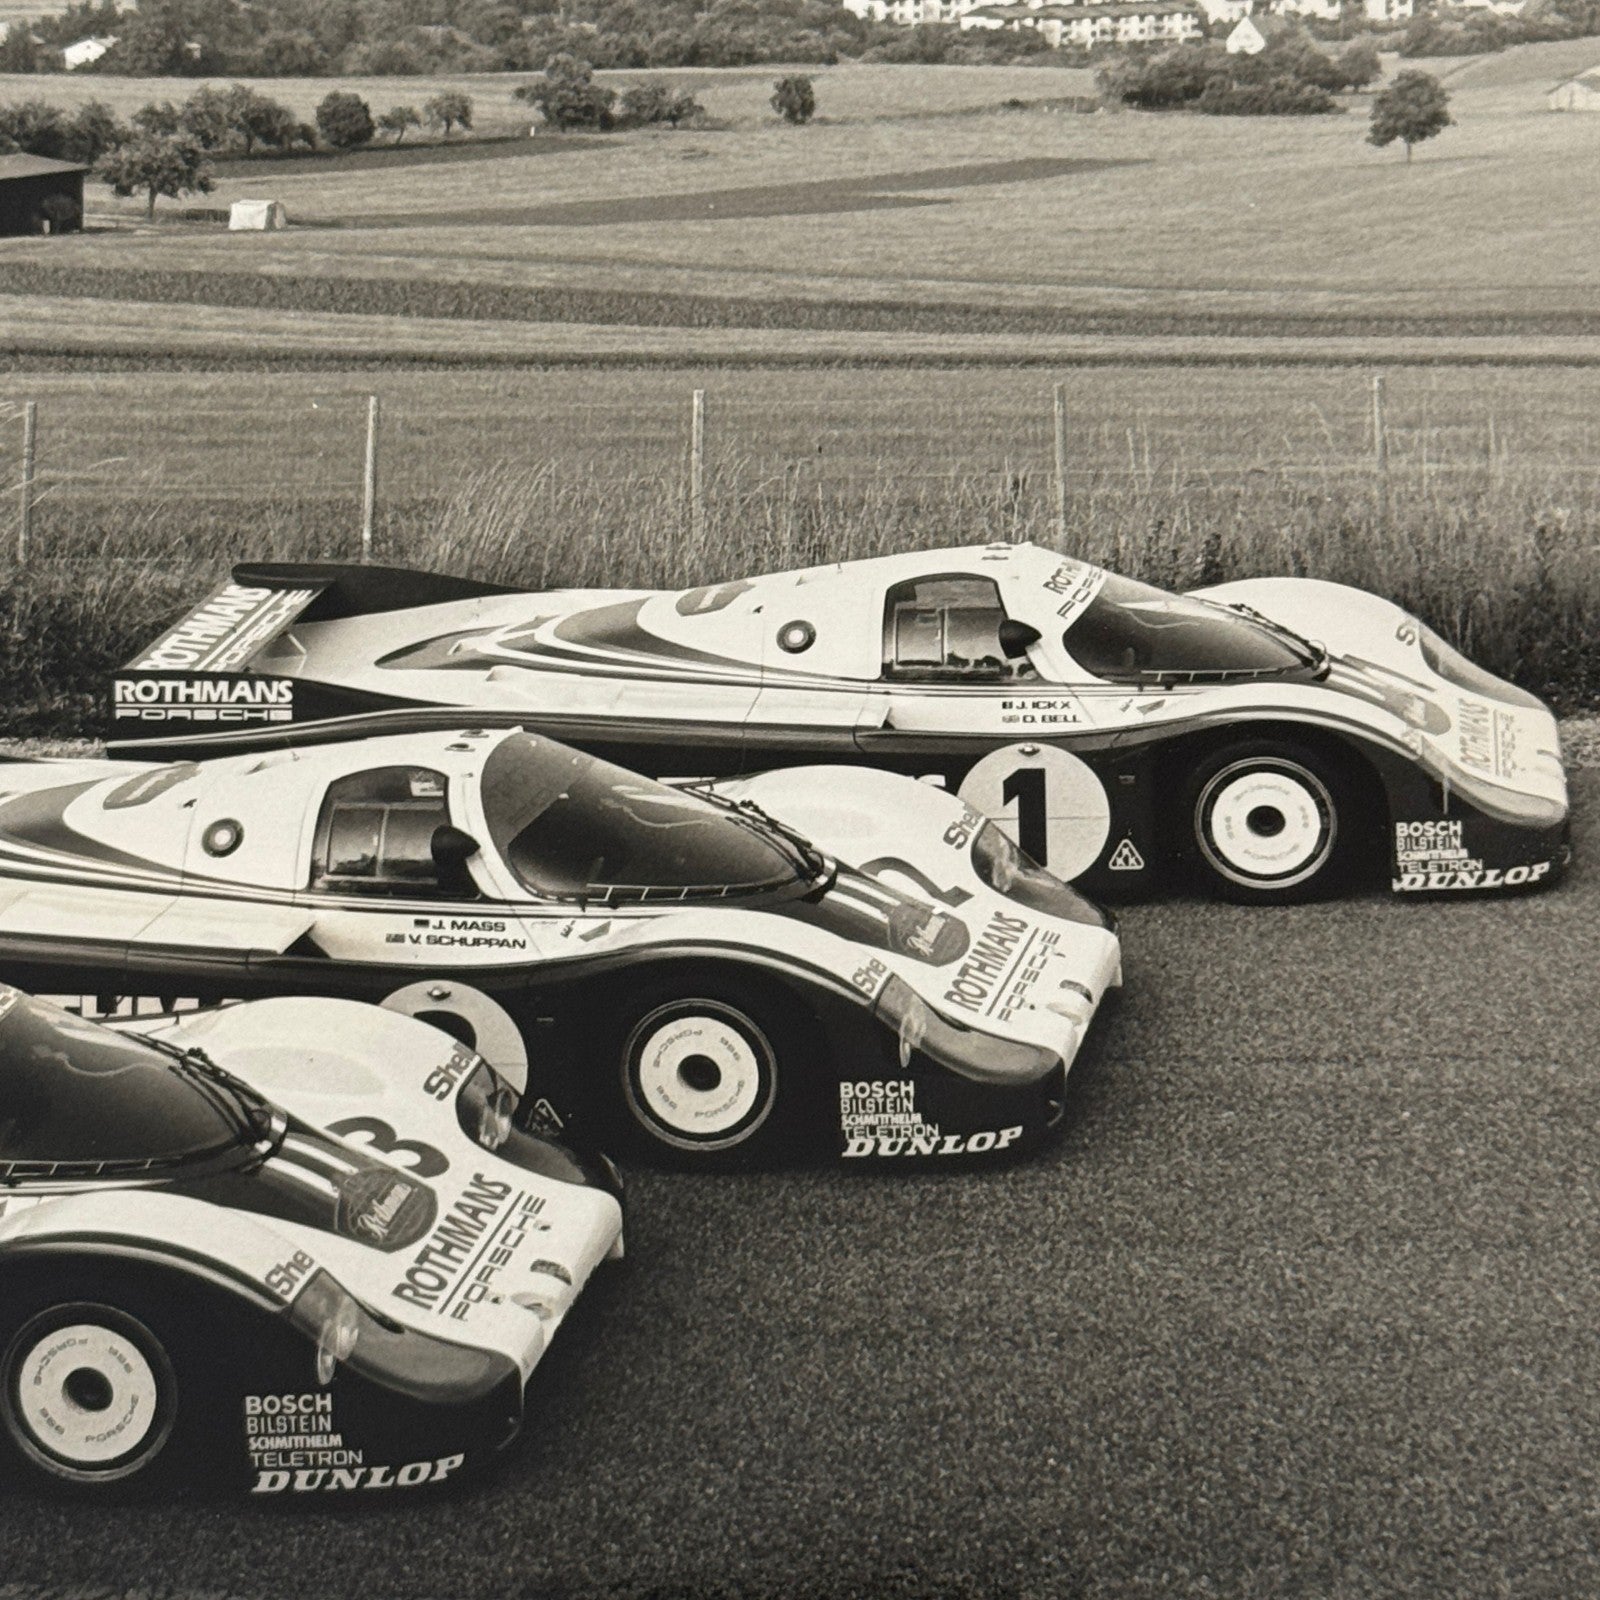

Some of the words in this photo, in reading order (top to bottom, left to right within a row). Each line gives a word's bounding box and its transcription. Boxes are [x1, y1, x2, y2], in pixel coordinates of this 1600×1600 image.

[114, 679, 293, 704] ROTHMANS
[115, 709, 293, 721] PORSCHE
[1041, 714, 1081, 724] BELL
[1003, 768, 1047, 867] 1
[1395, 820, 1462, 838] BOSCH
[1396, 836, 1461, 851] BILSTEIN
[1397, 859, 1484, 874] TELETRON
[1392, 862, 1551, 893] DUNLOP
[432, 922, 446, 932] J.
[450, 921, 506, 933] MASS
[408, 934, 421, 945] V.
[425, 934, 527, 949] SCHUPPAN
[943, 910, 1029, 1013] ROTHMANS
[997, 930, 1061, 1023] PORSCHE
[840, 1080, 914, 1099] BOSCH
[841, 1098, 914, 1114] BILSTEIN
[841, 1125, 1023, 1158] DUNLOP
[842, 1123, 939, 1140] TELETRON
[391, 1172, 512, 1310] ROTHMANS
[450, 1194, 546, 1322] PORSCHE
[245, 1393, 333, 1415] BOSCH
[247, 1414, 332, 1435] BILSTEIN
[251, 1449, 363, 1467] TELETRON
[251, 1453, 464, 1494] DUNLOP
